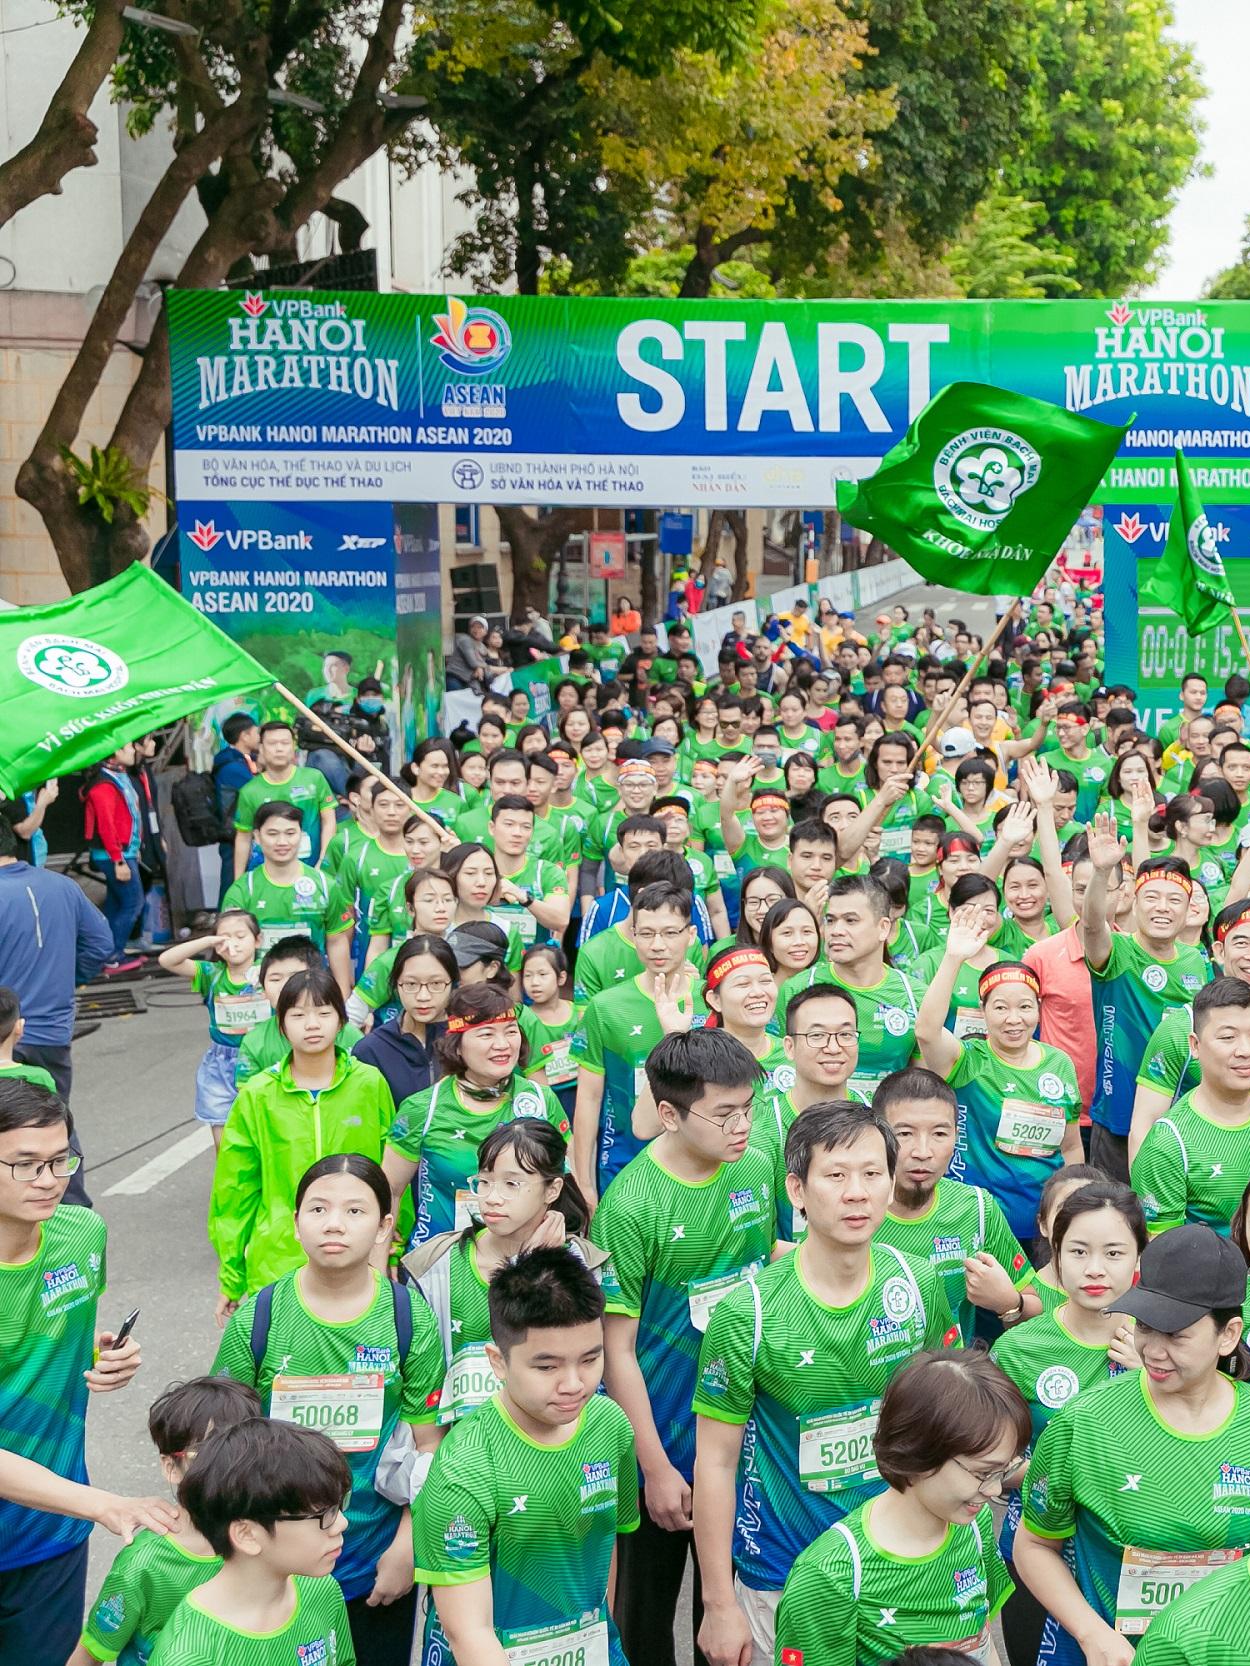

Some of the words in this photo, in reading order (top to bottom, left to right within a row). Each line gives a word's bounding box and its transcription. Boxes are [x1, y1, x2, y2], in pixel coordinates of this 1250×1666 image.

[271, 300, 347, 319] VPBank
[1137, 308, 1207, 327] VPBank
[227, 318, 367, 352] HANOI
[1095, 327, 1225, 359] HANOI
[196, 356, 400, 412] MARATHON
[615, 318, 950, 432] START
[443, 383, 506, 406] ASEAN
[196, 425, 263, 443] VPBANK
[267, 426, 318, 443] HANOI
[322, 426, 413, 444] MARATHON
[416, 427, 469, 445] ASEAN
[473, 428, 512, 445] 2020
[1125, 430, 1174, 448] HANOI
[310, 461, 343, 472] THAO
[350, 476, 384, 488] THAO
[612, 480, 644, 492] THAO
[1110, 468, 1165, 488] HANOI
[226, 530, 313, 551] VPBank
[189, 570, 249, 587] VPBANK
[253, 570, 300, 587] HANOI
[304, 571, 387, 587] MARATHON
[192, 592, 259, 613] ASEAN
[264, 591, 314, 613] 2020
[225, 1010, 257, 1022] 51964
[1012, 1122, 1052, 1142] 52037
[732, 1193, 753, 1206] HANOI
[935, 1242, 961, 1252] HANOI
[47, 1268, 79, 1289] HANOI
[866, 1329, 911, 1356] MARATHON
[356, 1352, 391, 1362] HANOI
[292, 1404, 359, 1427] 50068
[585, 1467, 611, 1484] HANOI
